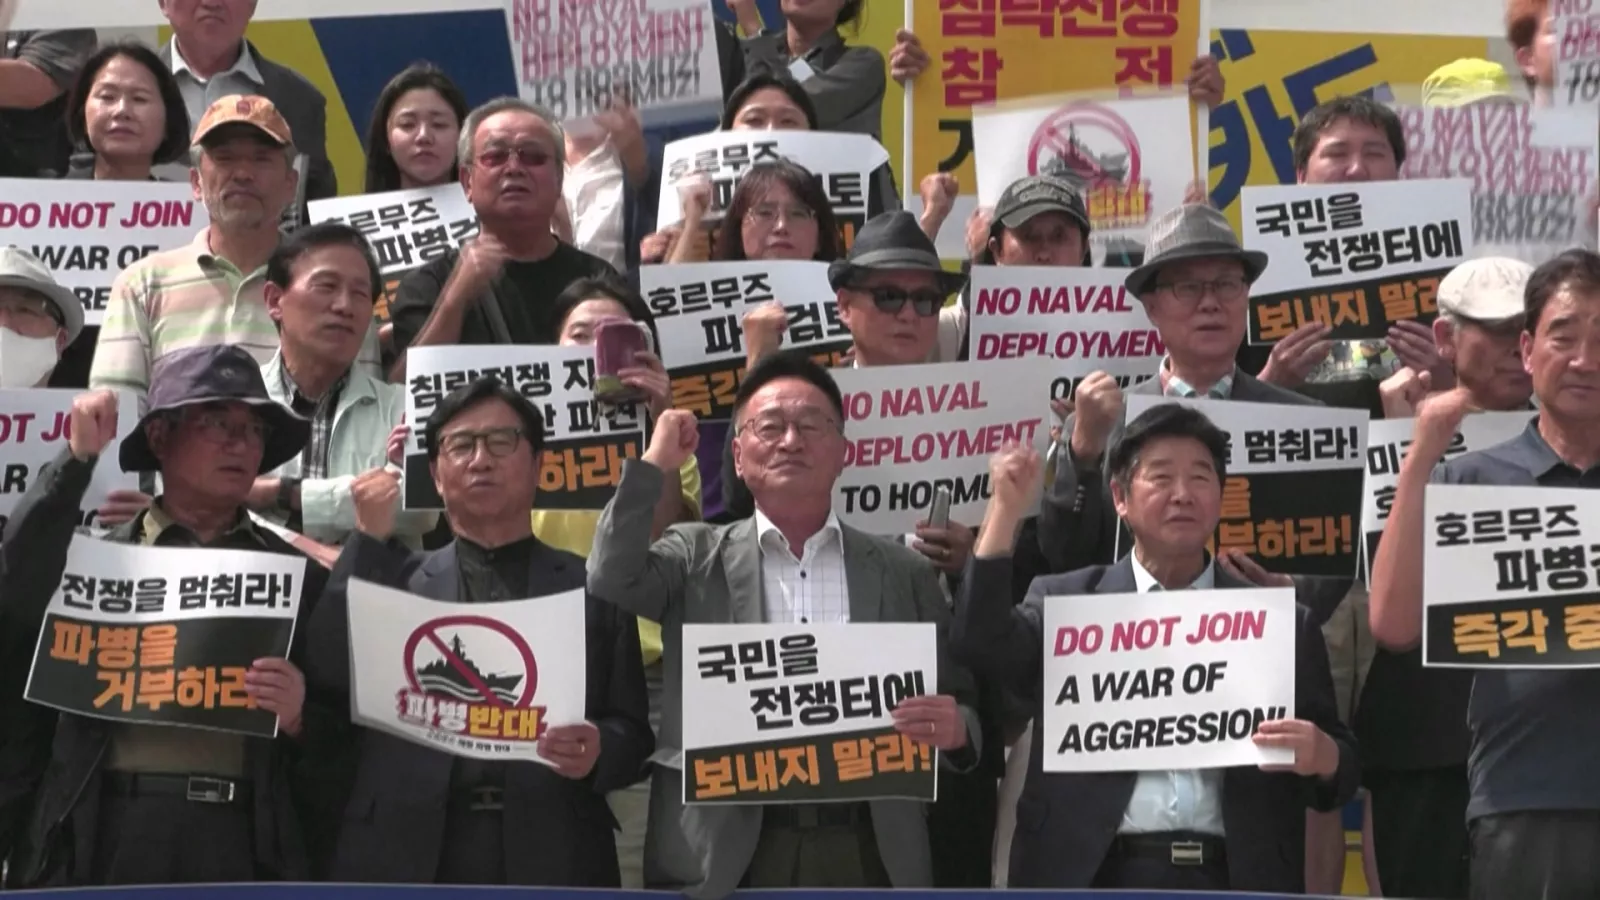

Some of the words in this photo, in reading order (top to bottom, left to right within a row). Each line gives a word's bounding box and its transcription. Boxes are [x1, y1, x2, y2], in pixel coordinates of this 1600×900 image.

[48, 201, 115, 229] NOT
[120, 200, 193, 228] JOIN
[326, 196, 441, 236] 르무즈
[1255, 191, 1364, 238] 국민을
[1303, 219, 1464, 279] 전쟁터에
[648, 272, 774, 318] 호르무즈
[975, 288, 1022, 316] NO
[1027, 285, 1133, 314] NAVAL
[1257, 288, 1370, 341] 보내지
[976, 330, 1165, 361] DEPLOYMEN
[879, 380, 988, 418] NAVAL
[842, 417, 1042, 469] DEPLOYMENT
[1244, 426, 1359, 465] 멈춰라!
[841, 485, 881, 514] TO
[1206, 514, 1353, 559] 부하라!
[1434, 504, 1582, 547] 호르무즈
[1493, 544, 1600, 593] 파병
[61, 573, 168, 614] 전쟁을
[179, 573, 293, 611] 멈춰라!
[50, 620, 178, 669] 파병을
[1054, 624, 1105, 657] DO
[1110, 616, 1182, 652] NOT
[1186, 610, 1267, 645] JOIN
[1453, 607, 1549, 659] 즉각
[697, 633, 819, 684] 국민을
[750, 669, 926, 731] 전쟁터에
[1055, 675, 1081, 706] A
[1091, 666, 1176, 703] WAR
[1182, 661, 1228, 695] OF
[694, 744, 821, 799] 보내지
[832, 731, 932, 783] 말라!
